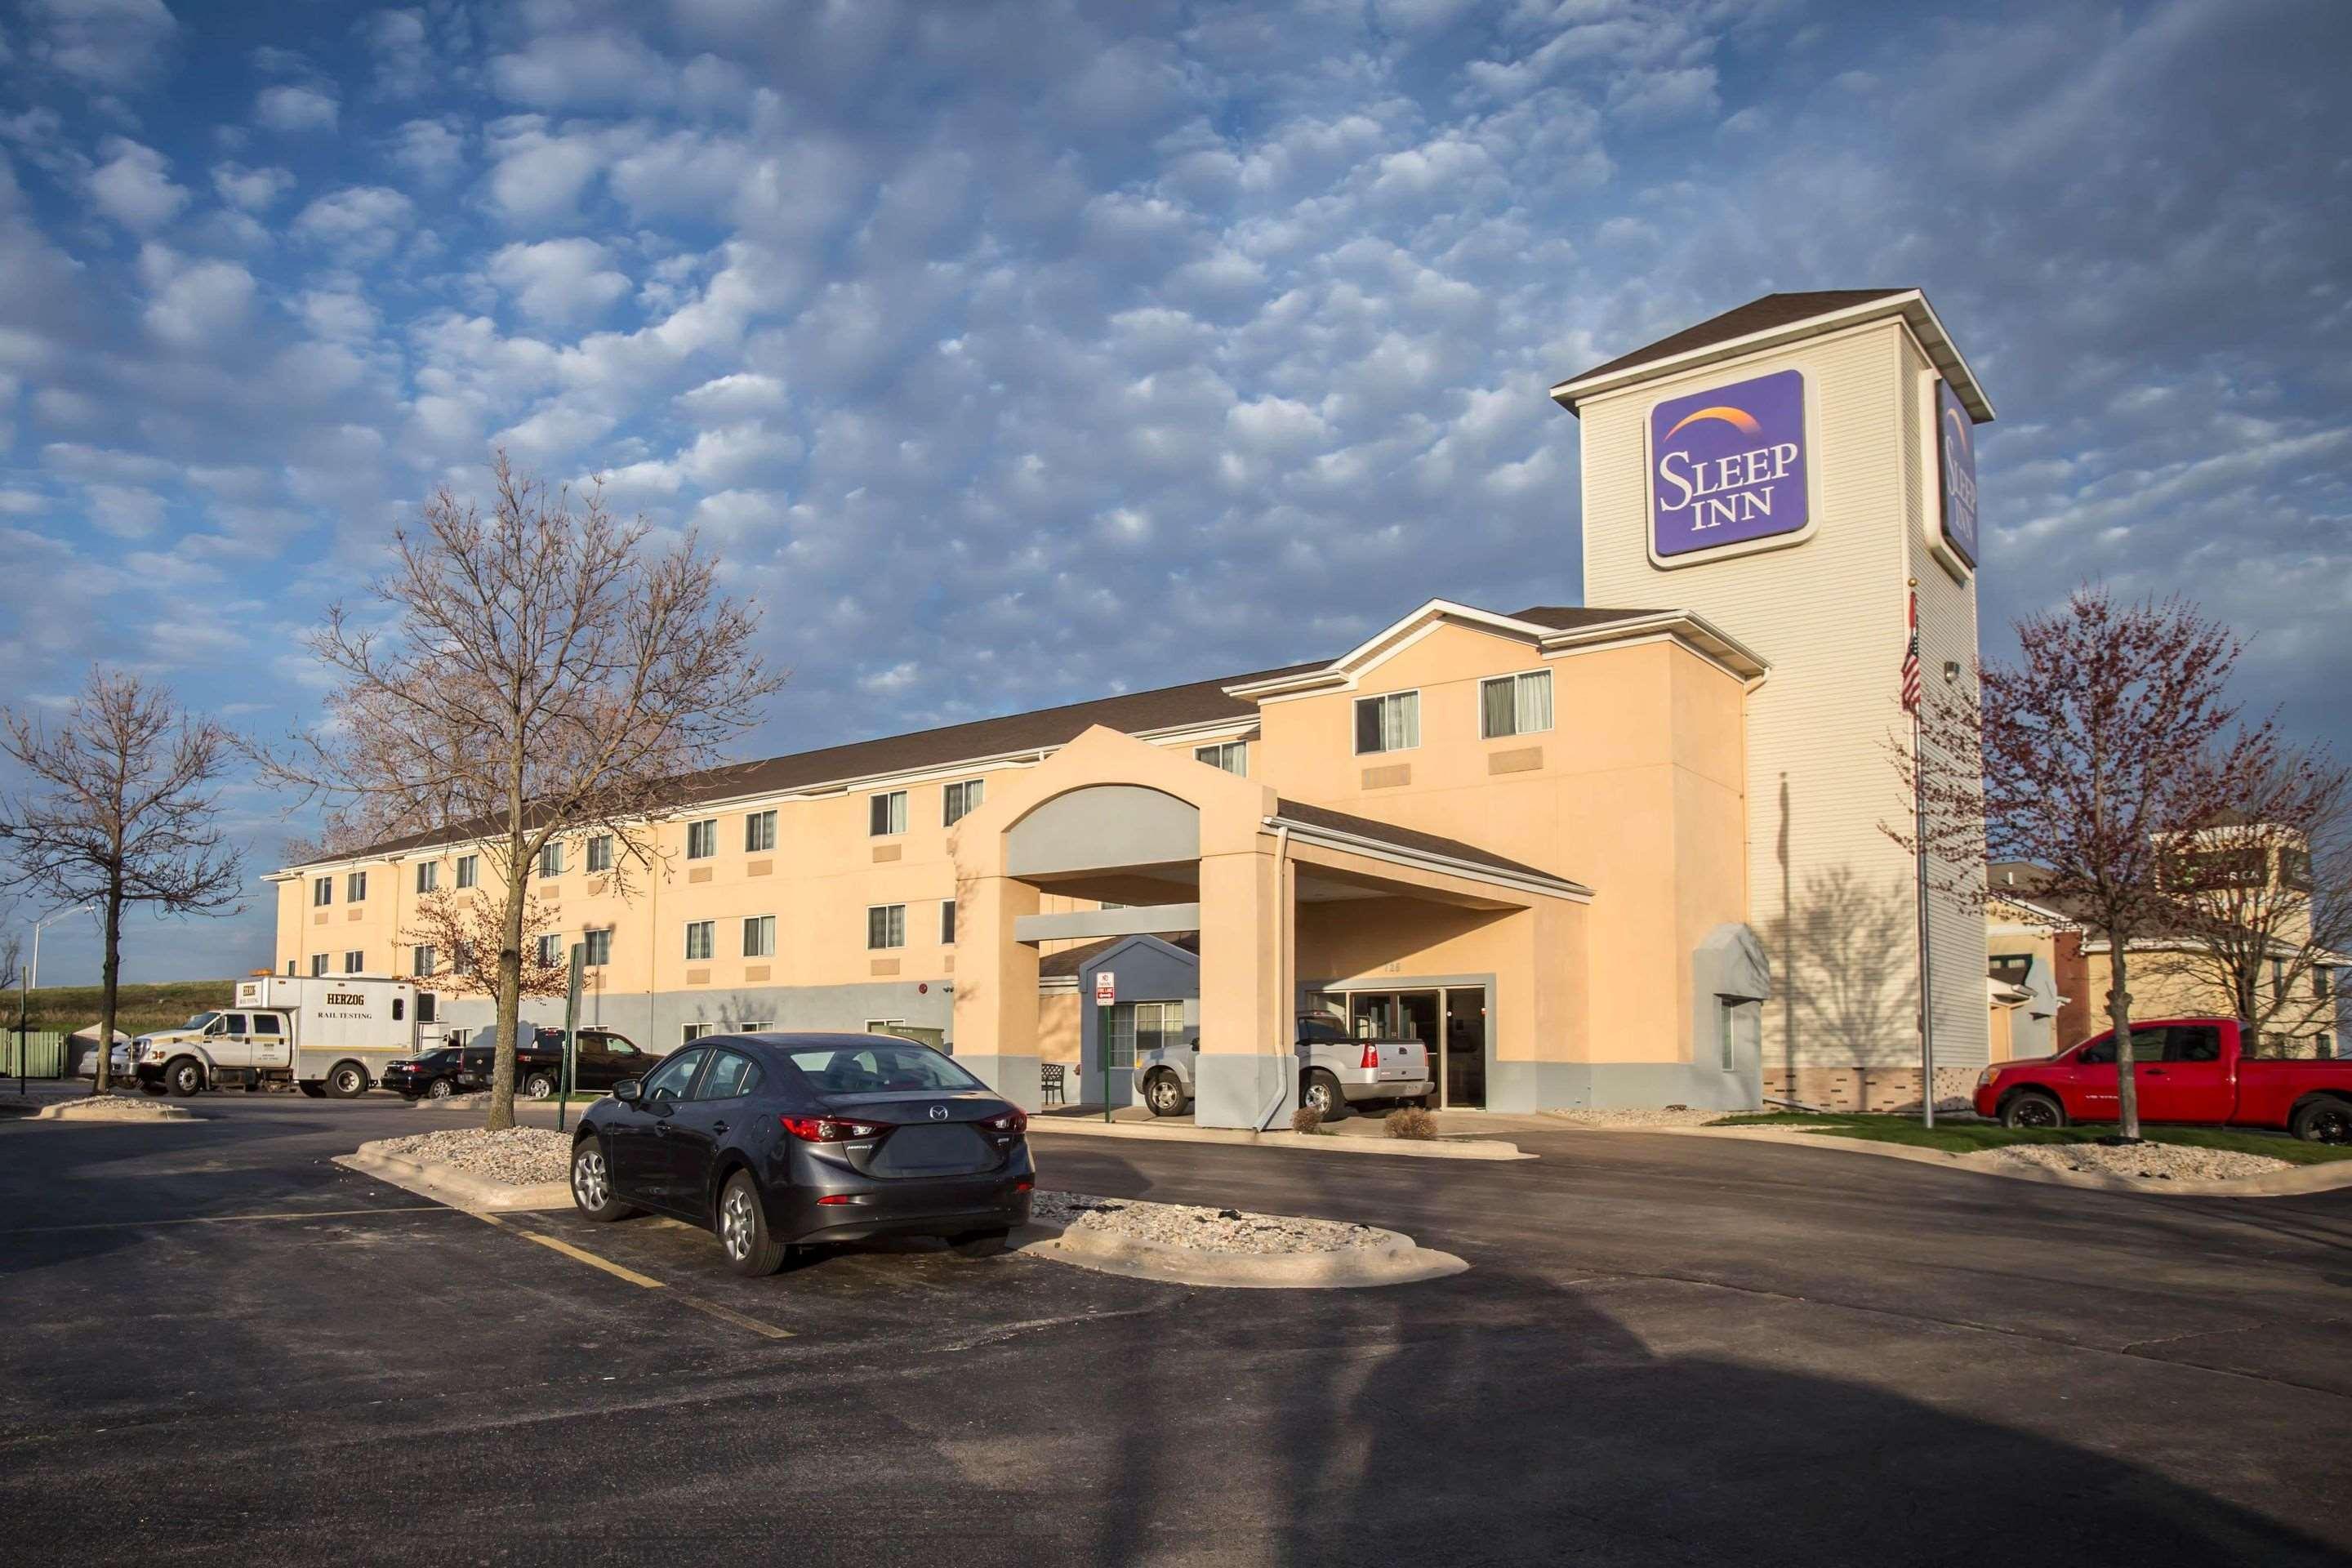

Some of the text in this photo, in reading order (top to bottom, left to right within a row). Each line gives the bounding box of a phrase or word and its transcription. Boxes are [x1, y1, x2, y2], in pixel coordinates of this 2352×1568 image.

[1659, 443, 1798, 512] SLEEP
[1690, 486, 1775, 531] INN
[327, 993, 364, 1005] HERZOG
